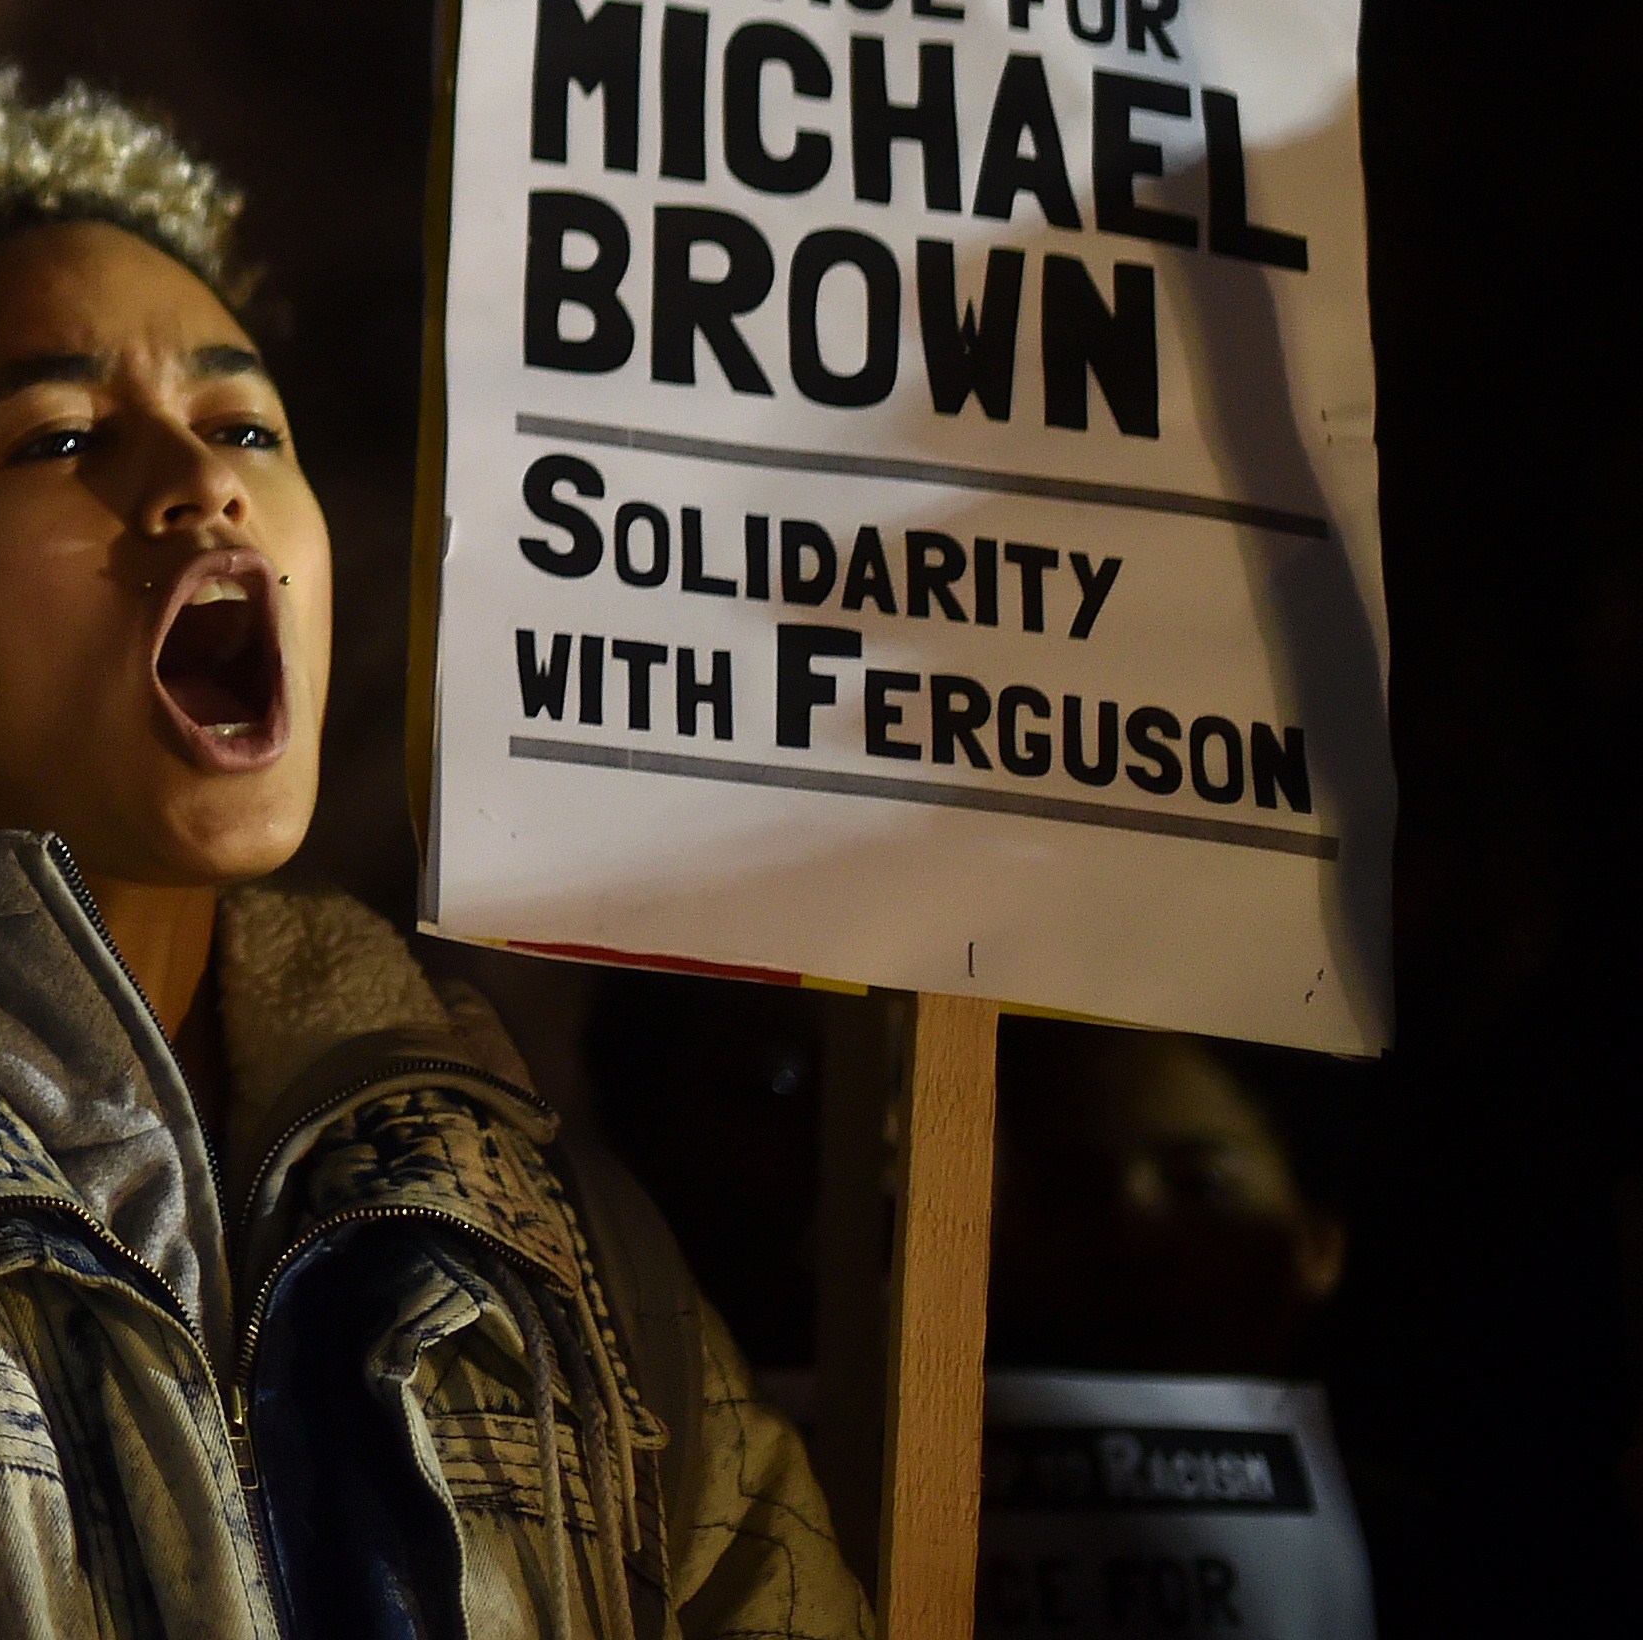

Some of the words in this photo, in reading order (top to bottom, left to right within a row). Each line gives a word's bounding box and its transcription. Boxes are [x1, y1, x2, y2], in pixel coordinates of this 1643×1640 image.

[524, 190, 1160, 439] BROWN
[517, 453, 1123, 641] SOLIDARITY
[515, 627, 733, 742] WITH
[774, 622, 1314, 815] FERGUSON
